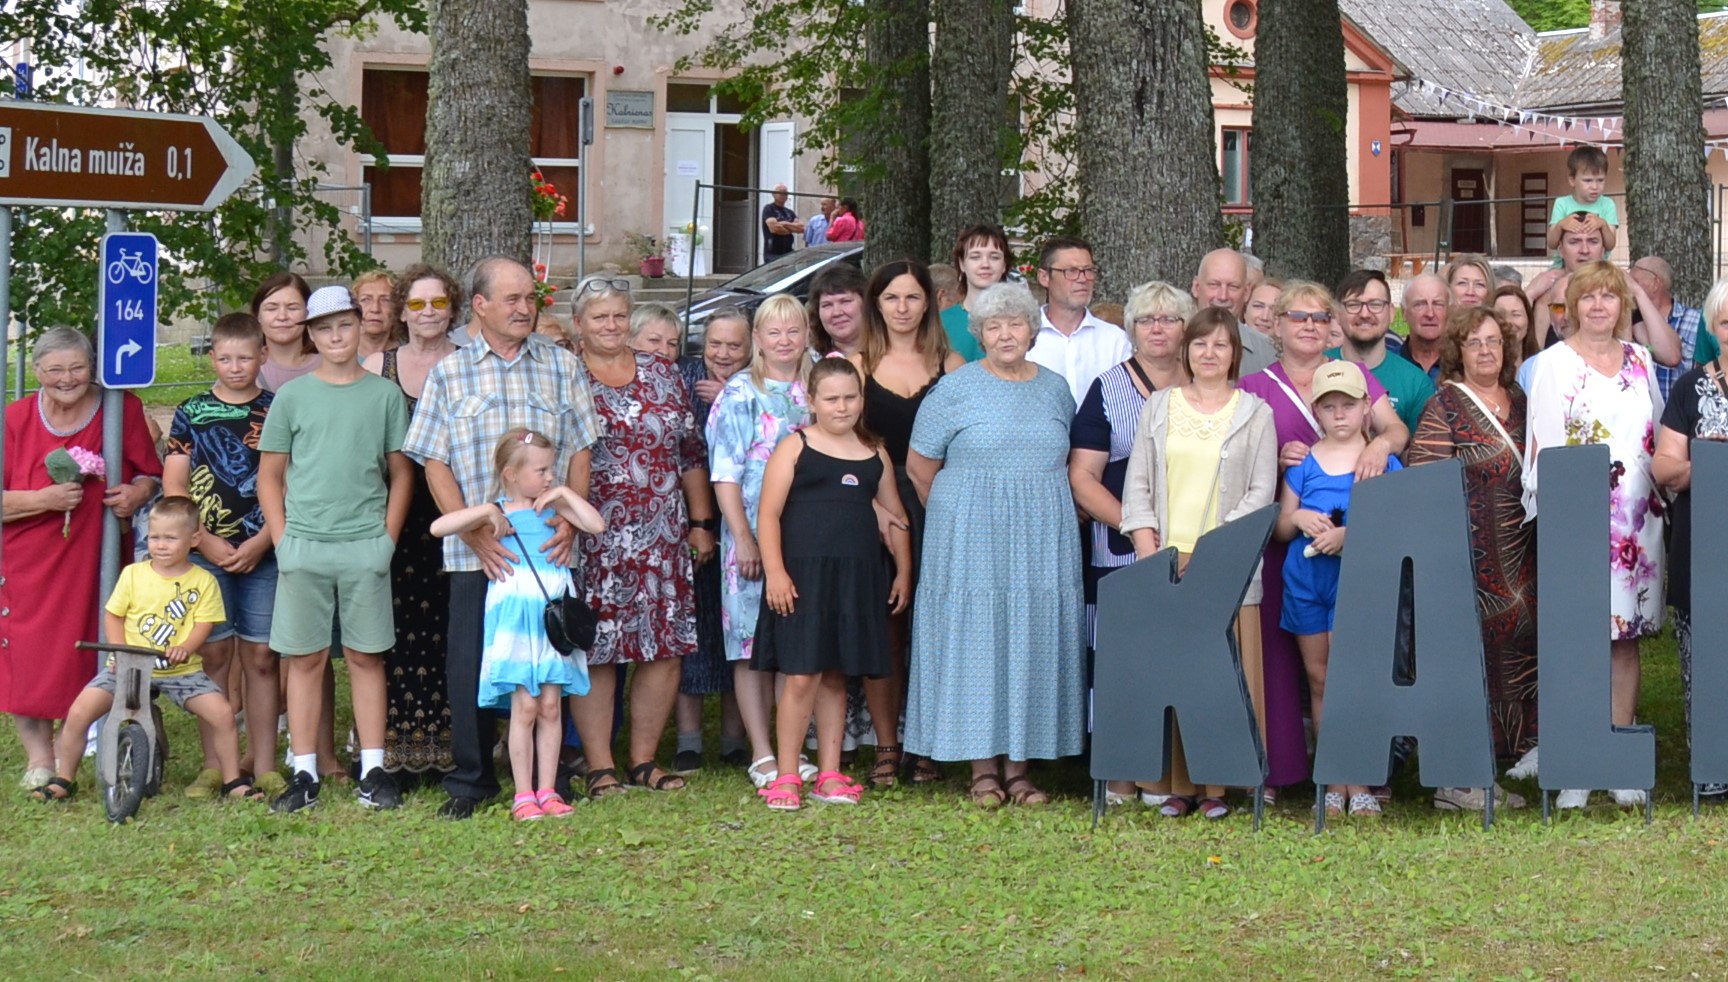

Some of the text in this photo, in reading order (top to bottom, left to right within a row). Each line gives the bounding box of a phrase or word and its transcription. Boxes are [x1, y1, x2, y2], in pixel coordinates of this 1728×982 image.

[25, 136, 192, 180] Kalna muiža 0,1
[115, 299, 144, 321] 164
